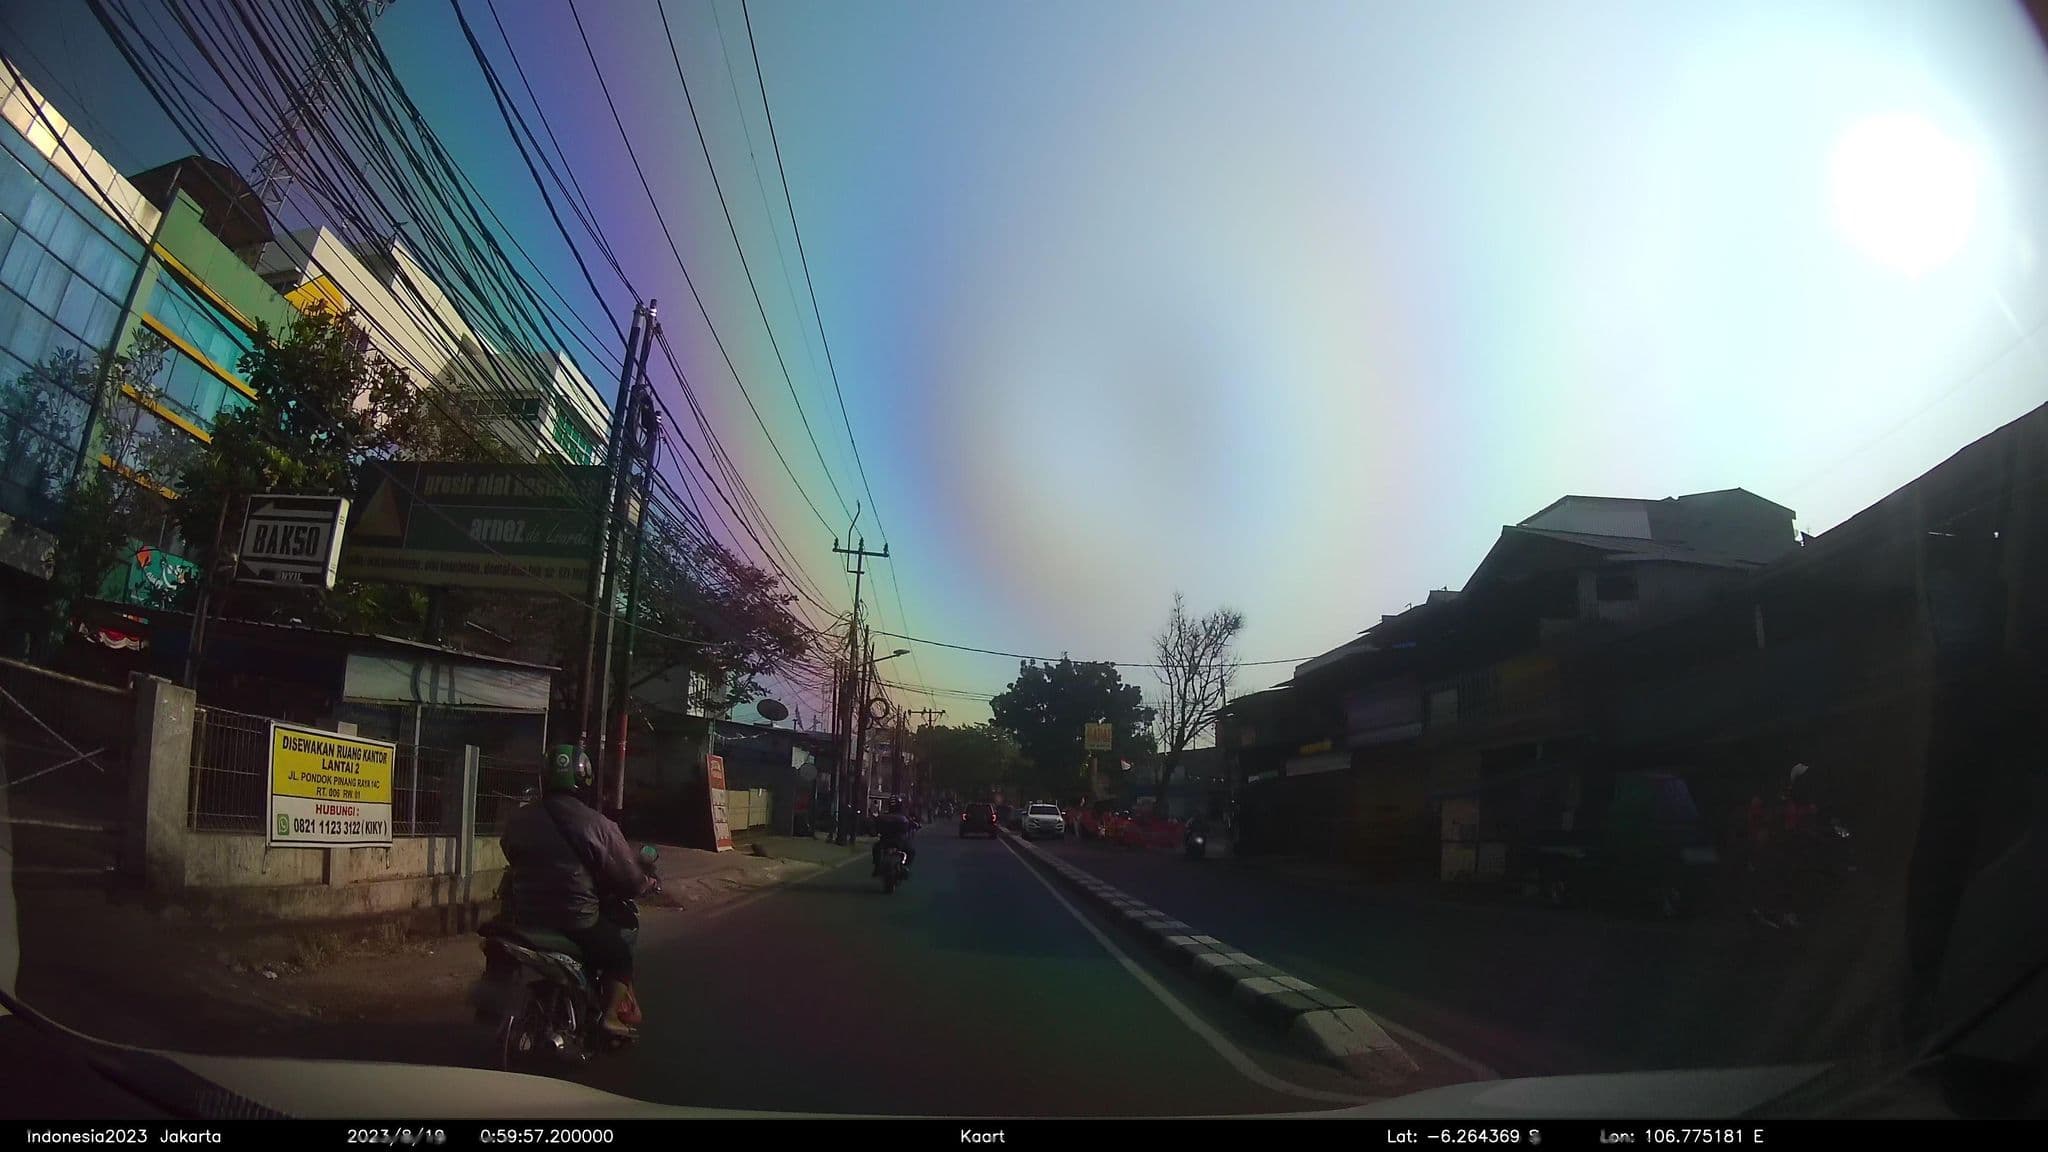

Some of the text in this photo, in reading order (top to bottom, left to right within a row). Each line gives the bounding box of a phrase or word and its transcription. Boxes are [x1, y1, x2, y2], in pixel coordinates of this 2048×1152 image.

[470, 518, 526, 544] arnez
[253, 524, 320, 557] BAKSO
[282, 735, 388, 764] DISEWAKAN RUANG KANTOR
[322, 758, 360, 774] LANTAI 2
[301, 772, 332, 785] PONDOK
[333, 777, 356, 788] PINANG
[357, 779, 371, 788] RAYA
[328, 788, 340, 798] 006
[293, 818, 316, 833] 0821
[319, 820, 342, 835] 1123
[343, 821, 361, 835] 3122
